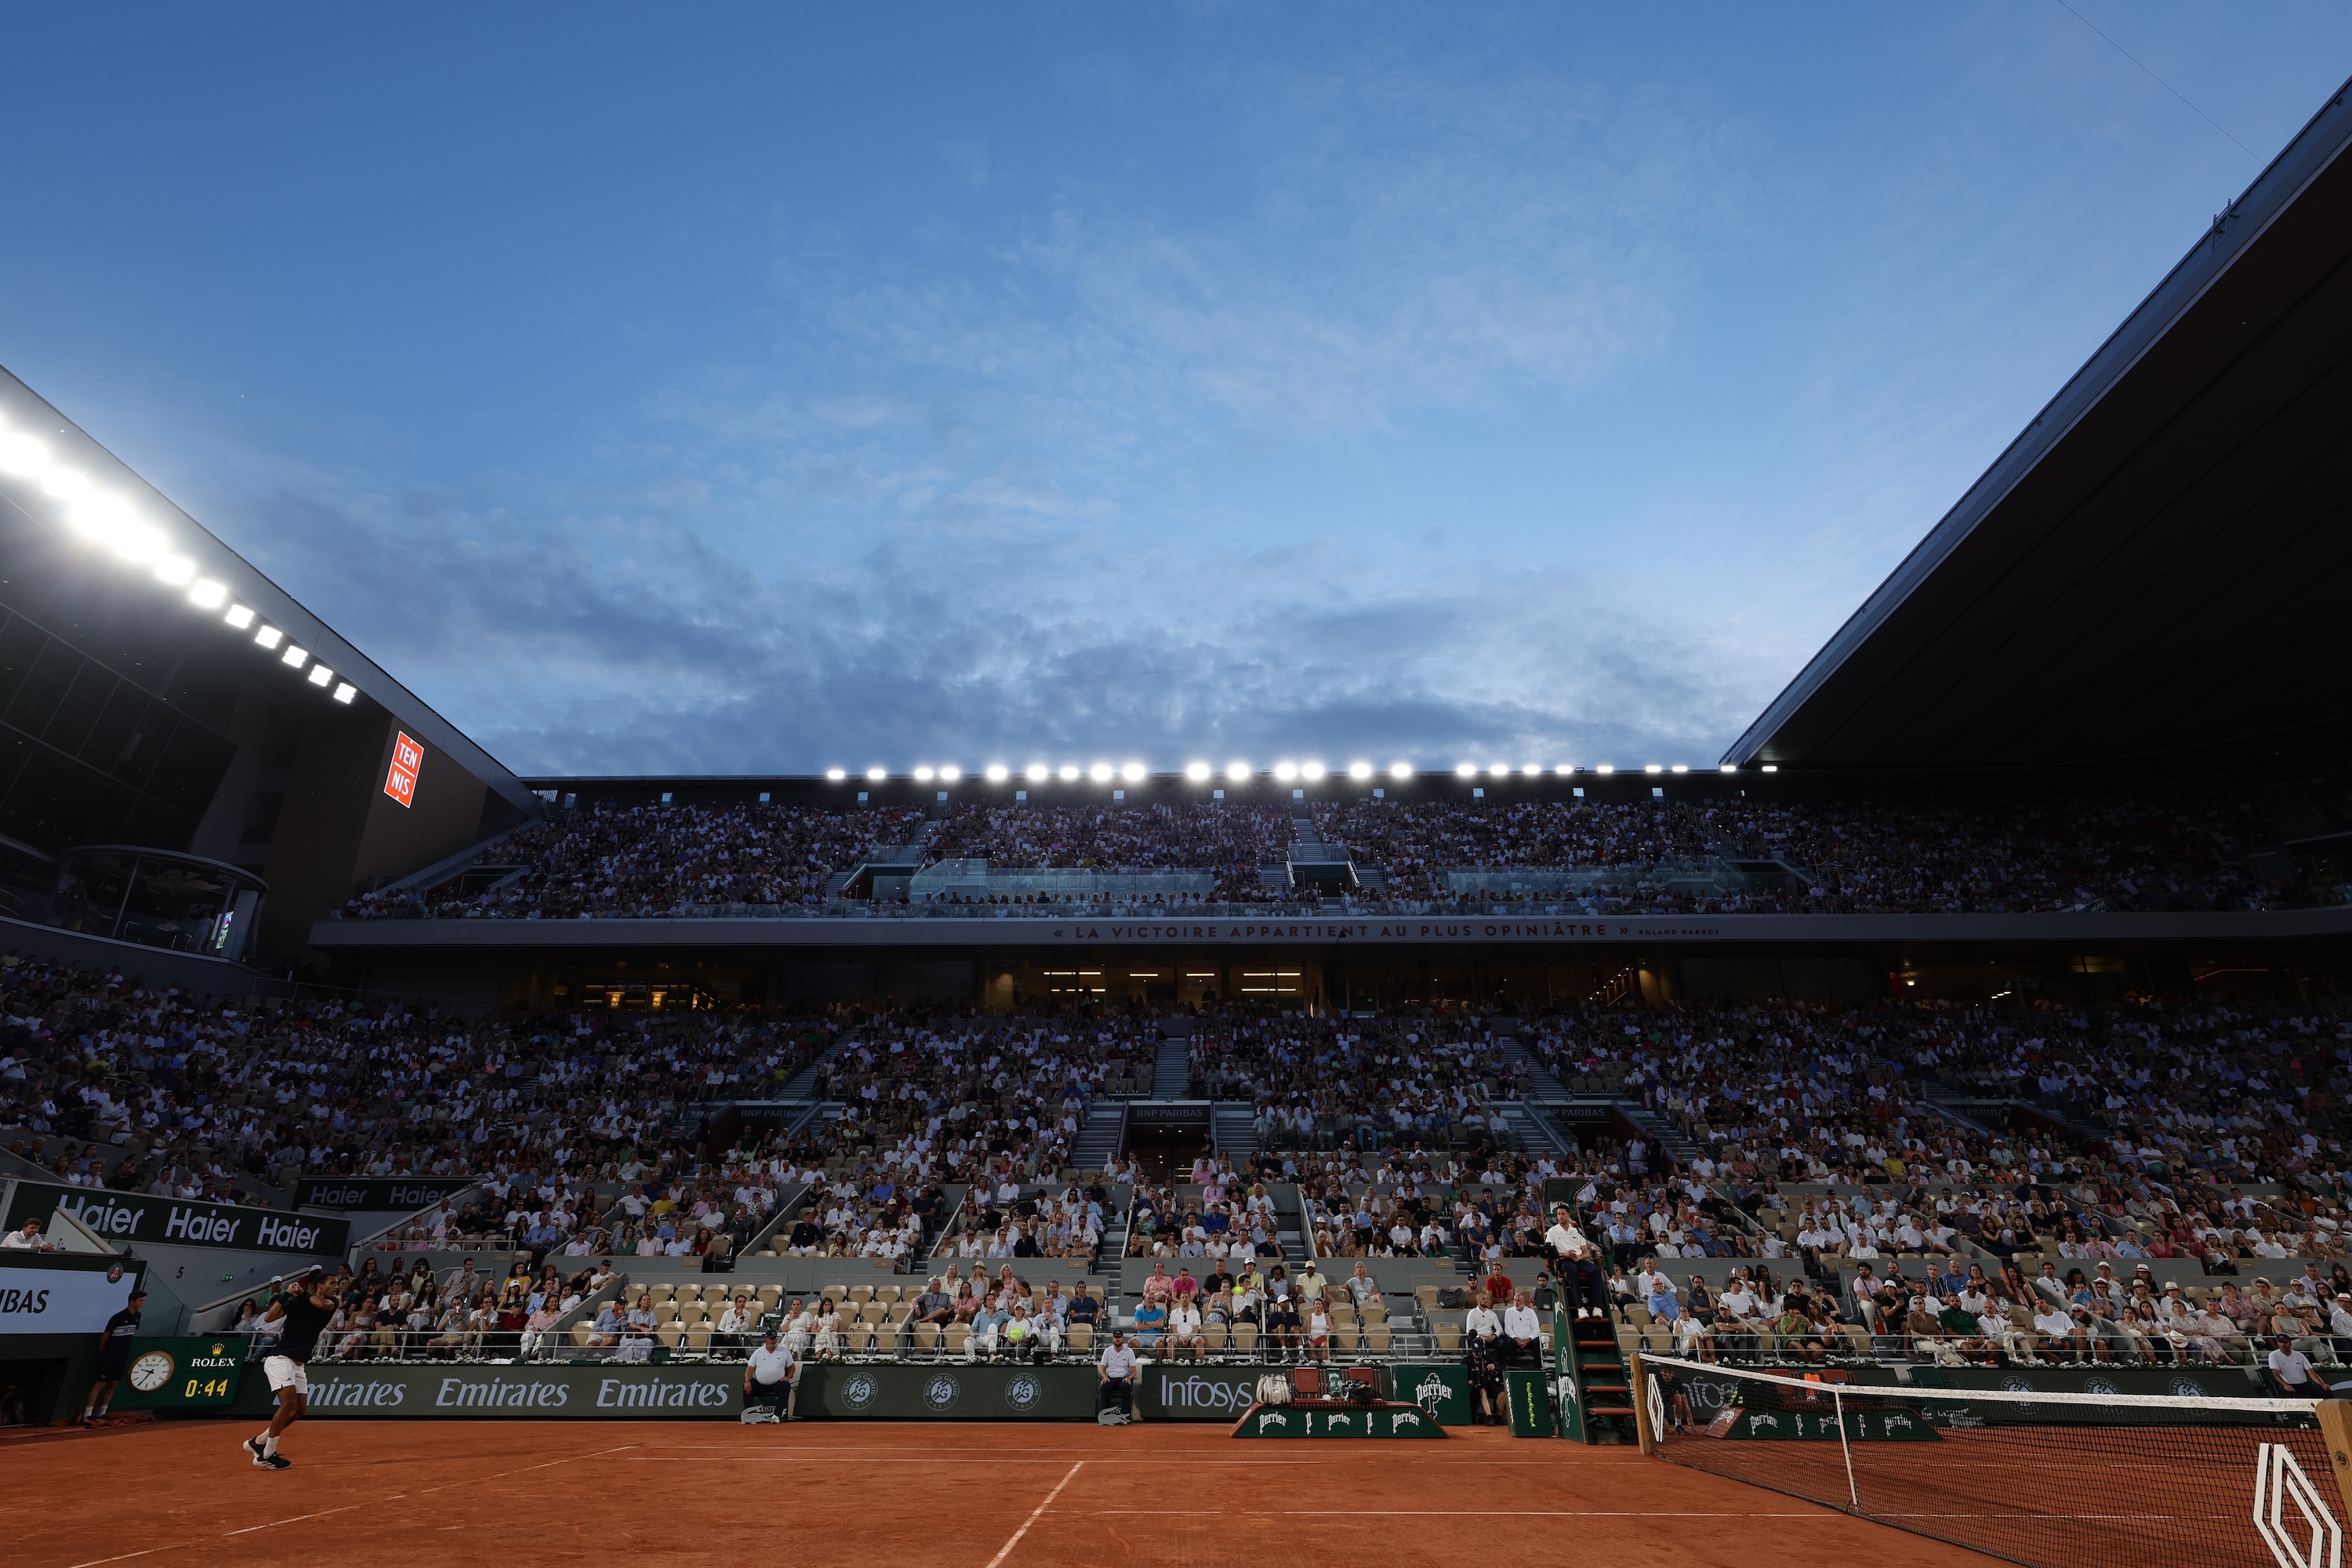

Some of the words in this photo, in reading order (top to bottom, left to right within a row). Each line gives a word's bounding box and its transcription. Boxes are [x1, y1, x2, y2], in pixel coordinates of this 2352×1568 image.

[399, 742, 418, 769] TEN
[391, 770, 411, 796] NIS
[1076, 927, 1099, 938] LA
[1112, 926, 1217, 938] VICTOIRE
[1229, 925, 1367, 938] APPARTIENT
[1381, 925, 1406, 937] AU
[1421, 925, 1471, 937] PLUS
[1485, 921, 1606, 937] OPINIÂTRE
[1160, 1109, 1203, 1117] PARIBAS
[1966, 1108, 2003, 1116] PARIBA
[310, 1185, 368, 1204] Haier
[165, 1206, 240, 1243] Haier
[257, 1215, 320, 1249] Haier
[176, 1266, 184, 1279] 5
[191, 1358, 236, 1367] ROLEX
[184, 1378, 229, 1398] 0:44
[273, 1377, 407, 1406] mirates
[435, 1377, 570, 1406] Emirates
[596, 1377, 729, 1407] Emirates
[1161, 1374, 1253, 1413] Infosys
[1415, 1380, 1453, 1407] perrier
[1258, 1411, 1287, 1435] perrier
[1327, 1413, 1350, 1431] perrier
[1392, 1410, 1420, 1434] perrier
